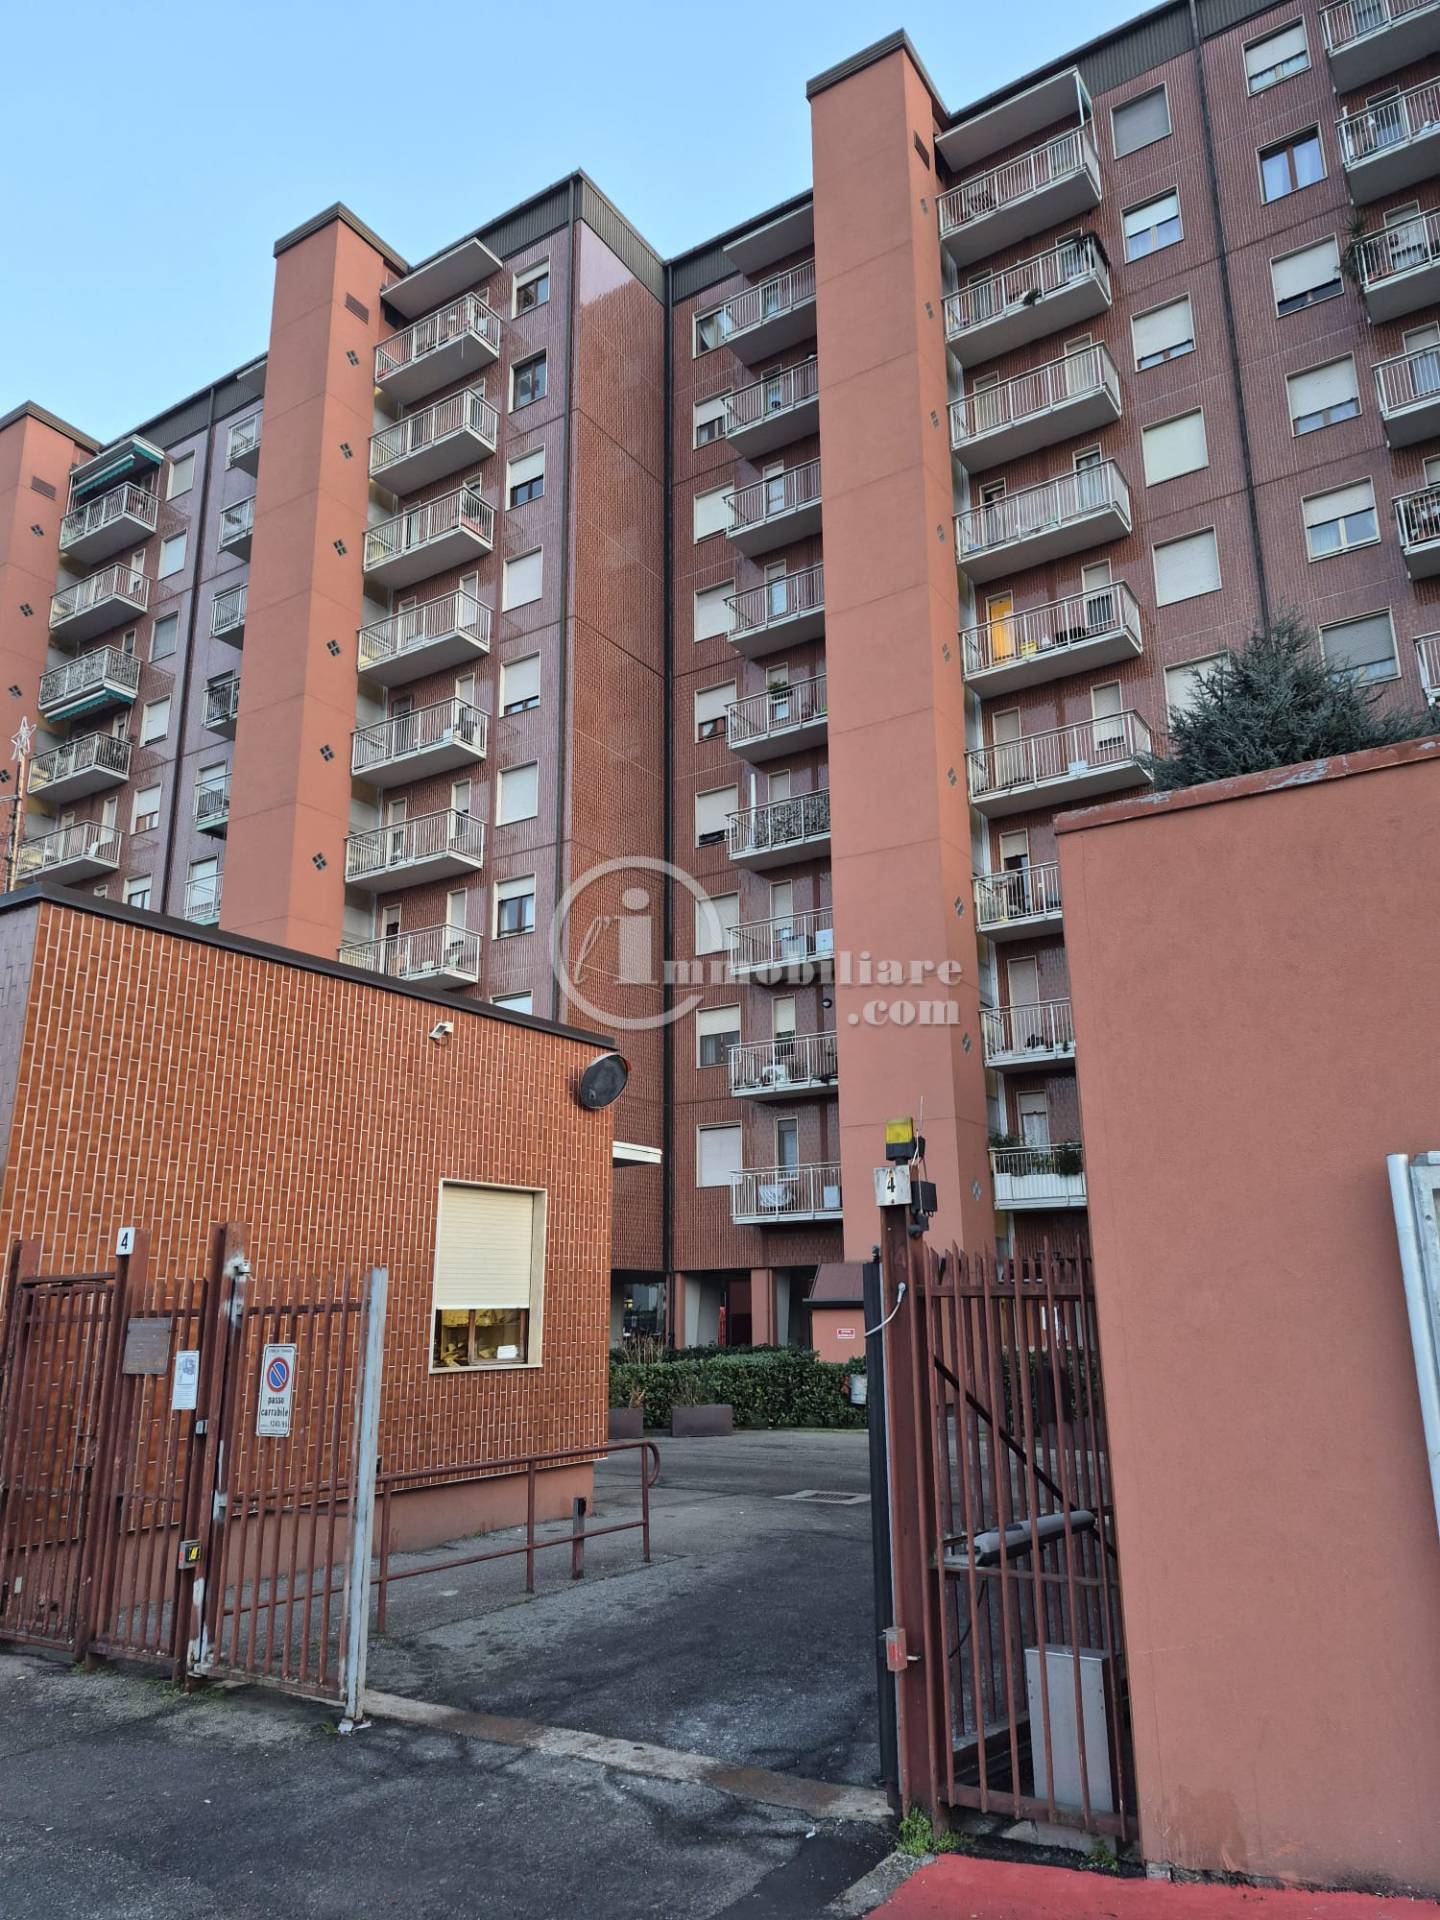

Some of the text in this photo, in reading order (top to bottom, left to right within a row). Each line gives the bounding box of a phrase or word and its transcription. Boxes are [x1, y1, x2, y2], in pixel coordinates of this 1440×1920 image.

[887, 1176, 896, 1193] 4
[120, 1232, 129, 1250] 4
[267, 1396, 285, 1406] passo
[260, 1407, 289, 1417] carrabile
